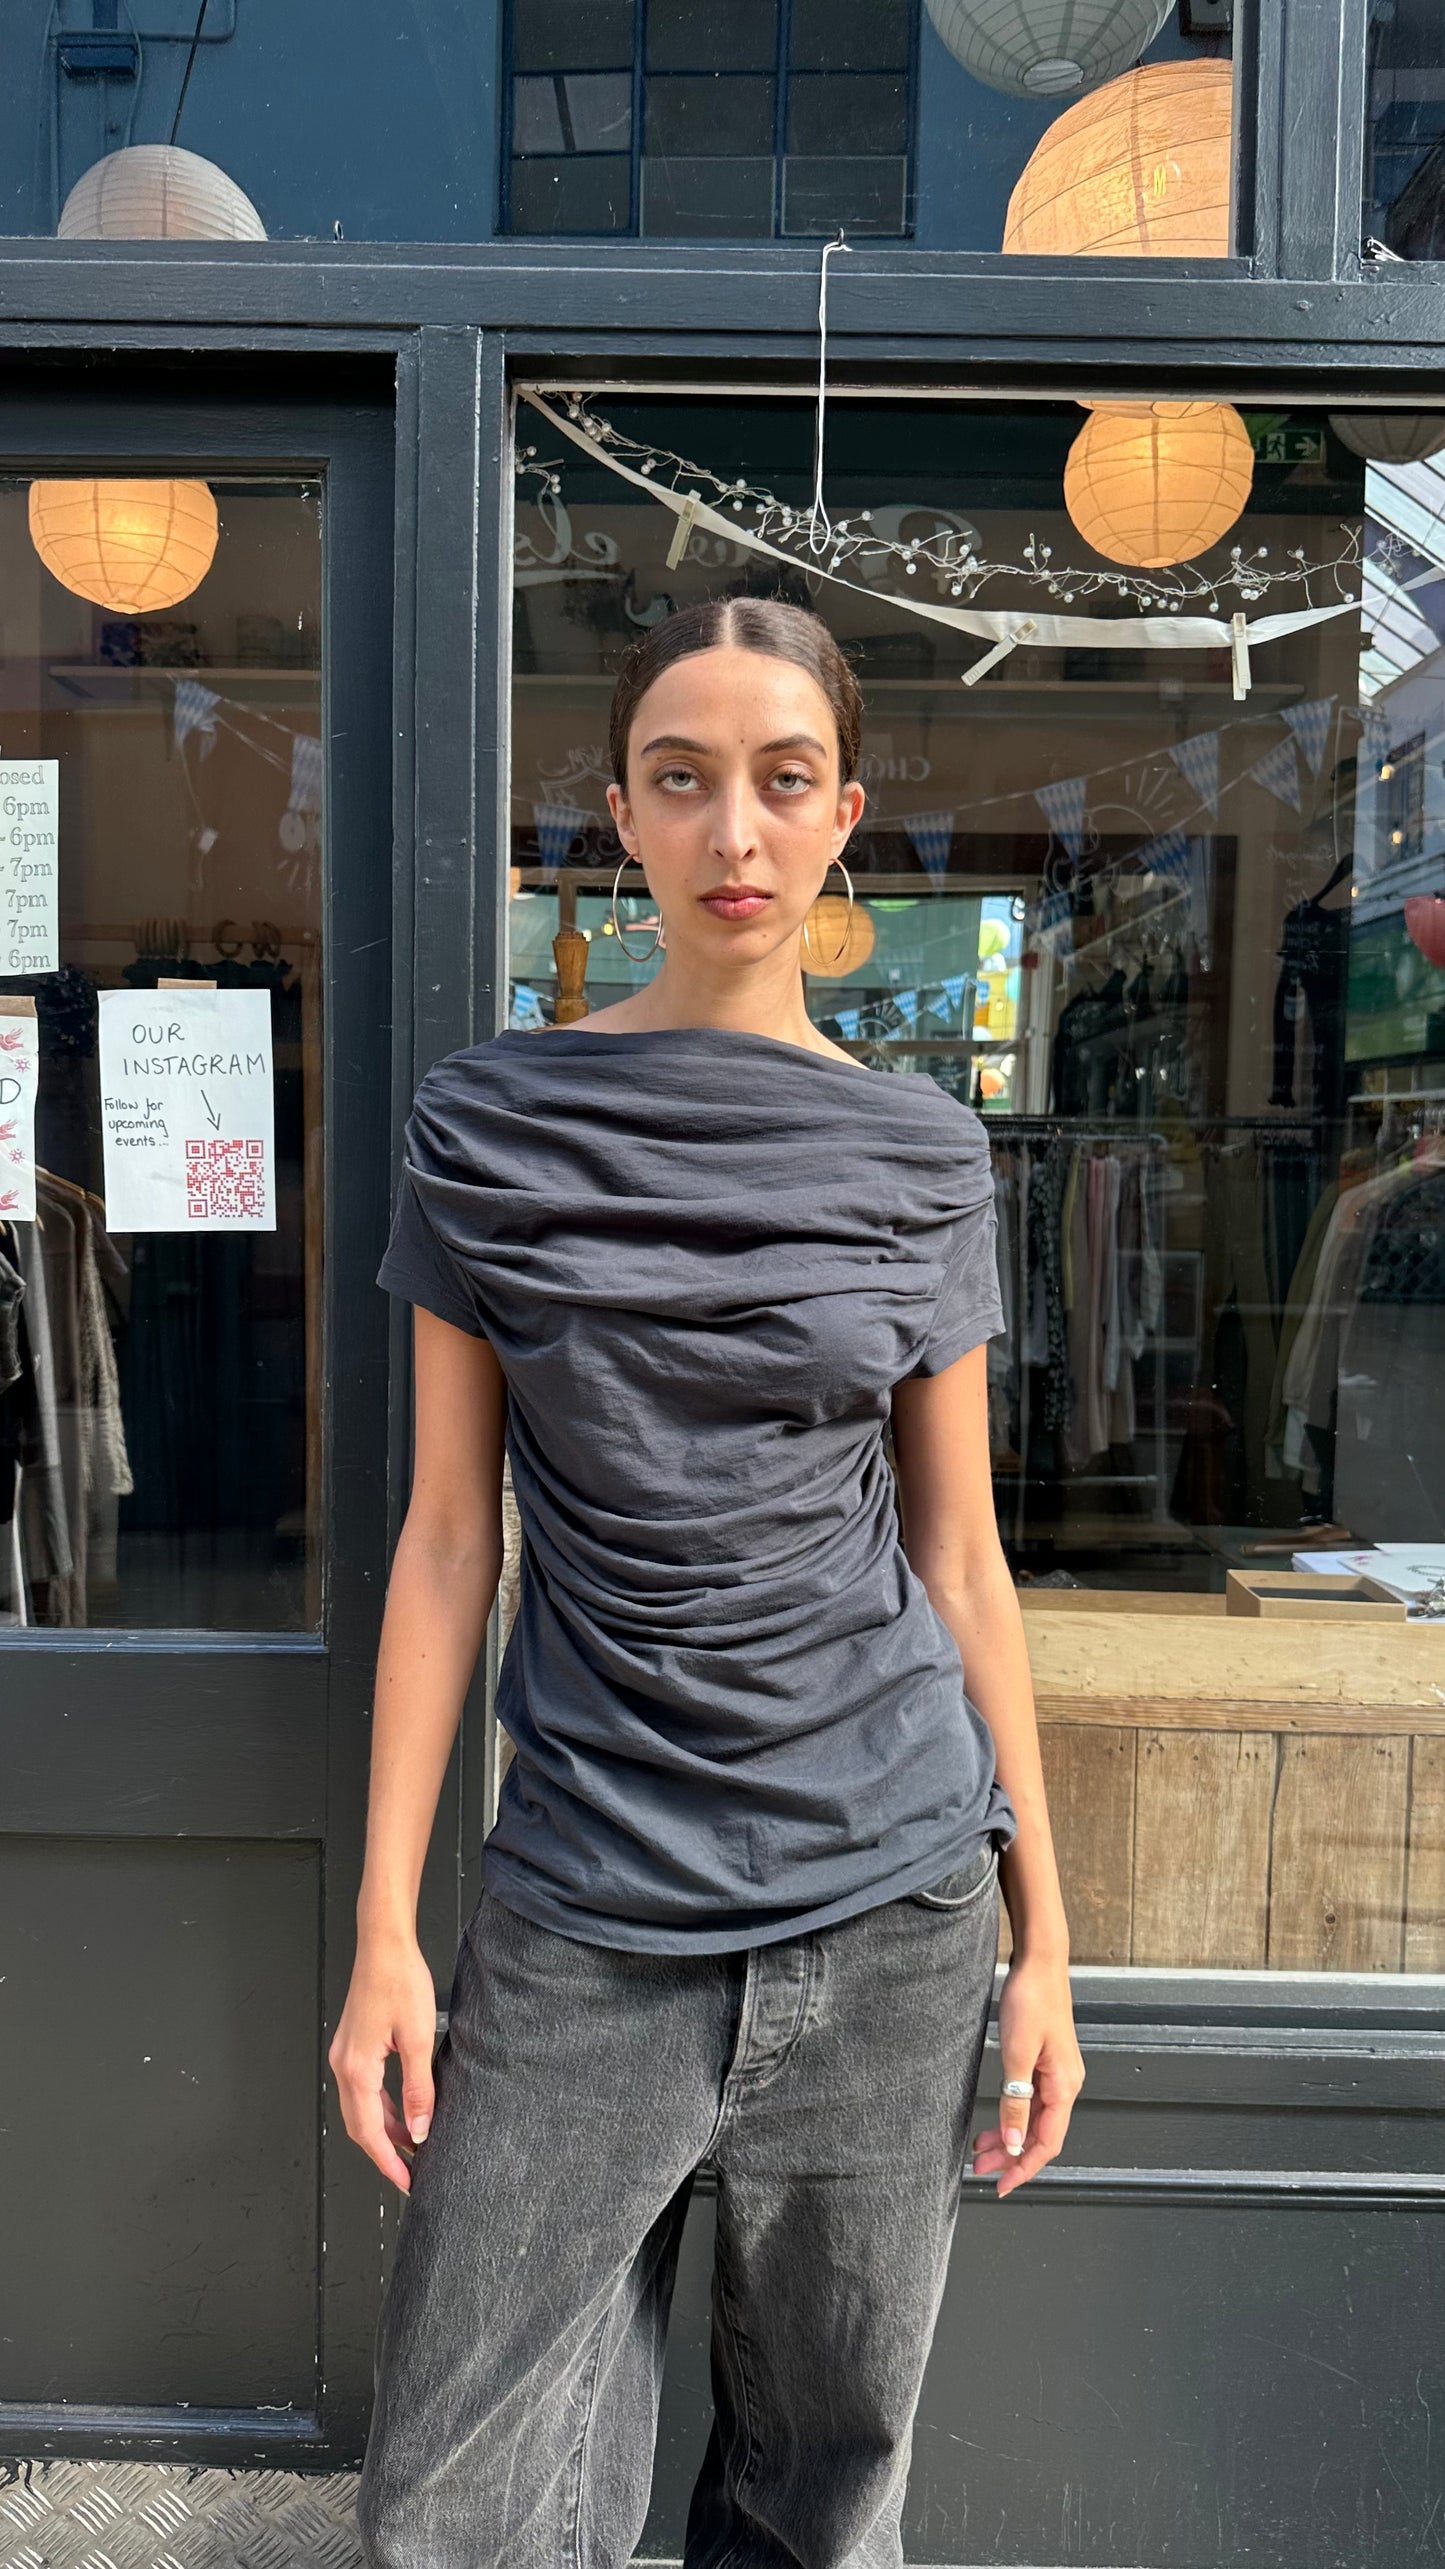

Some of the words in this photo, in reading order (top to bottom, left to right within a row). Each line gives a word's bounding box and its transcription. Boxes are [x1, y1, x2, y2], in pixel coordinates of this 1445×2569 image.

[132, 1022, 185, 1044] OUR
[123, 1053, 266, 1076] INSTAGRAM
[104, 1097, 138, 1110] Follow
[144, 1097, 164, 1119] for
[108, 1119, 169, 1138] upcoming
